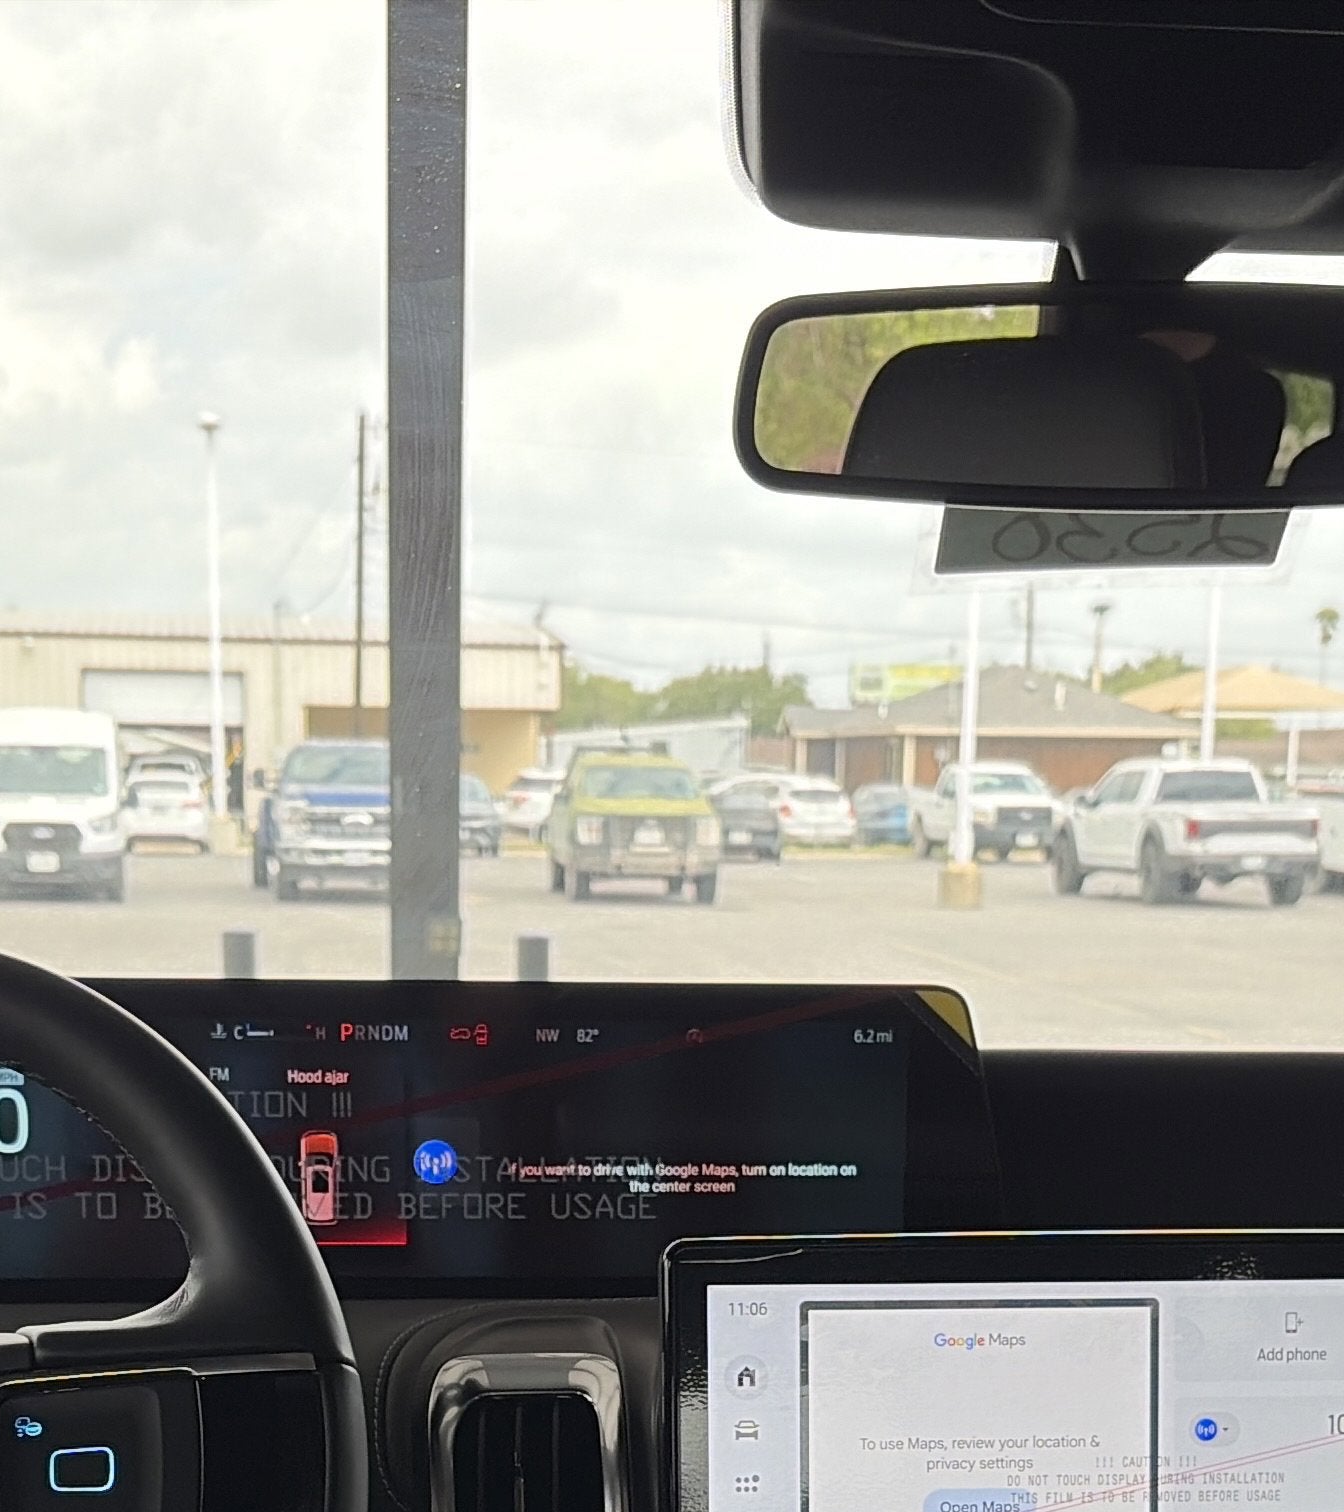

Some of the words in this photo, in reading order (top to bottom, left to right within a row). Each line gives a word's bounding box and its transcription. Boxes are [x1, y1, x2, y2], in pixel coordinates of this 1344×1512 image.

[535, 1028, 560, 1044] NW
[853, 1028, 874, 1044] 6.2
[876, 1028, 894, 1043] mi
[209, 1067, 231, 1082] FM
[287, 1069, 323, 1084] Hood
[324, 1070, 351, 1086] ajar
[226, 1091, 307, 1118] TION
[519, 1165, 543, 1180] you
[544, 1164, 576, 1177] want
[578, 1164, 591, 1177] to
[593, 1163, 624, 1177] drive
[626, 1163, 654, 1176] with
[655, 1163, 700, 1180] Google
[702, 1163, 739, 1180] Maps,
[741, 1164, 767, 1176] turn
[769, 1166, 786, 1176] on
[788, 1163, 838, 1176] location
[839, 1166, 857, 1176] on
[629, 1180, 651, 1193] the
[652, 1180, 692, 1193] center
[693, 1181, 736, 1193] screen
[12, 1192, 48, 1220] IS
[75, 1192, 117, 1220] TO
[397, 1192, 526, 1220] BEFORE
[550, 1192, 657, 1220] USAGE
[728, 1302, 768, 1316] 11:06
[934, 1332, 986, 1350] Google
[988, 1333, 1026, 1348] Maps
[1256, 1347, 1284, 1362] Add
[1286, 1347, 1327, 1365] phone
[859, 1437, 877, 1451] To
[879, 1439, 905, 1451] use
[907, 1437, 948, 1452] Maps,
[952, 1438, 995, 1450] review
[998, 1438, 1030, 1452] your
[1032, 1435, 1087, 1449] location
[1089, 1435, 1101, 1447] &
[926, 1457, 976, 1472] privacy
[979, 1456, 1034, 1472] settings
[1121, 1455, 1171, 1469] CAUTON
[1007, 1474, 1021, 1487] DO
[1027, 1474, 1049, 1487] NOT
[1056, 1473, 1091, 1487] TOUCH
[1097, 1473, 1146, 1486] DISPLAY
[1151, 1472, 1195, 1485] URING
[1202, 1471, 1285, 1485] INSTALLATION
[1011, 1491, 1038, 1504] THIS
[1045, 1491, 1073, 1504] FILM
[1121, 1490, 1136, 1503] BE
[1197, 1489, 1240, 1502] BEFORE
[1245, 1488, 1281, 1501] USAGE
